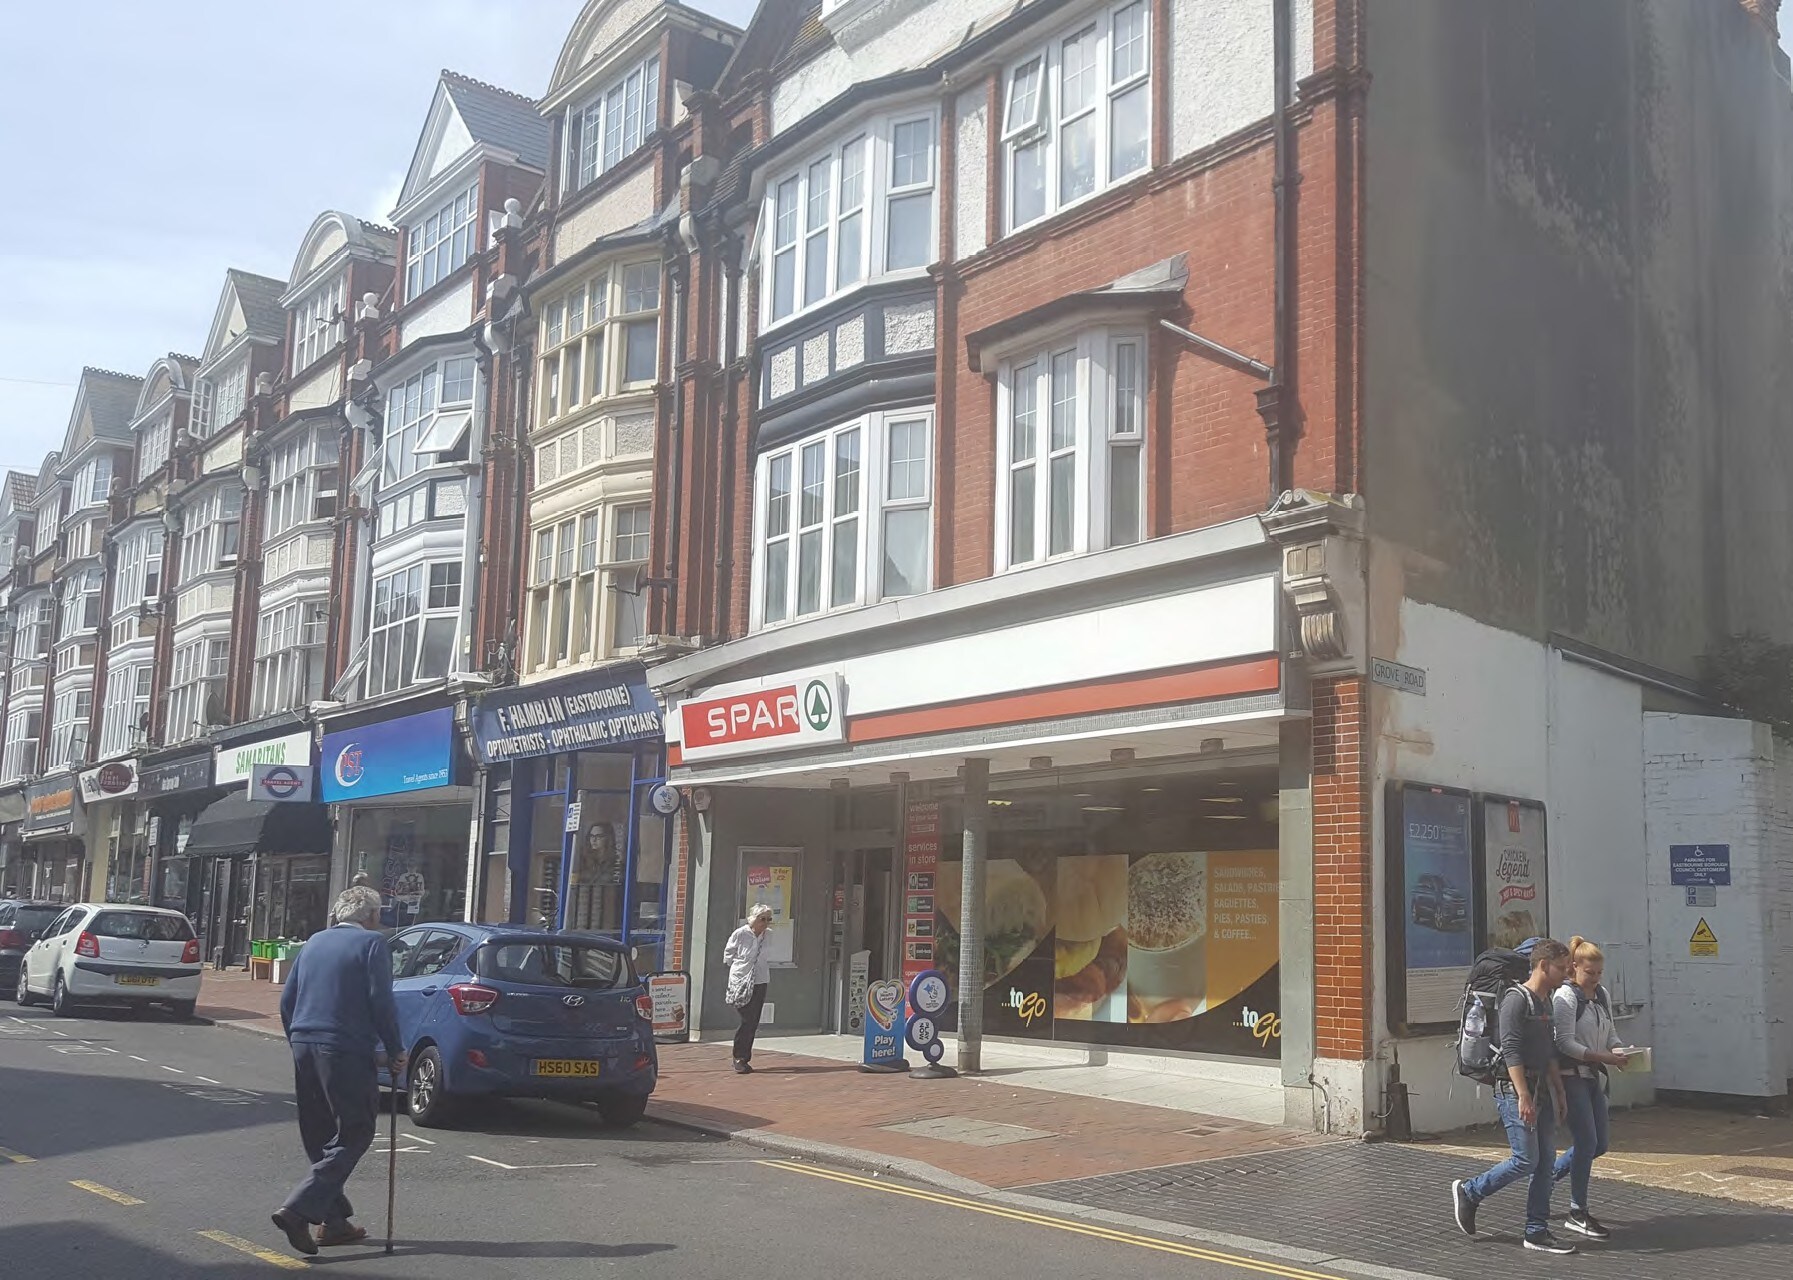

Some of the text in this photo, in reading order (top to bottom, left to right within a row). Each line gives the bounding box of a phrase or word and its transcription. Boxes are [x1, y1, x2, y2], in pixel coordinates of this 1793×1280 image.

[1374, 664, 1424, 688] GROVE ROAD
[497, 683, 630, 732] F. HAMBLIN (EASTBOURNE)
[708, 694, 798, 738] SPAR
[486, 732, 546, 758] OPTOMETRISTS
[551, 720, 608, 747] OPHTHALMIC
[608, 710, 660, 737] OPTICIANS
[235, 742, 286, 774] SAMARITANS
[908, 842, 938, 852] services
[910, 855, 936, 864] in store
[1503, 849, 1527, 862] CHICKEN
[1496, 852, 1530, 884] Legend
[749, 876, 770, 884] Value
[1214, 898, 1259, 909] BAGUETTES,
[1214, 913, 1232, 925] PIES,
[1018, 992, 1046, 1028] Go
[874, 1035, 894, 1046] Play
[872, 1047, 896, 1059] here!
[538, 1062, 597, 1074] HS60 SAS
